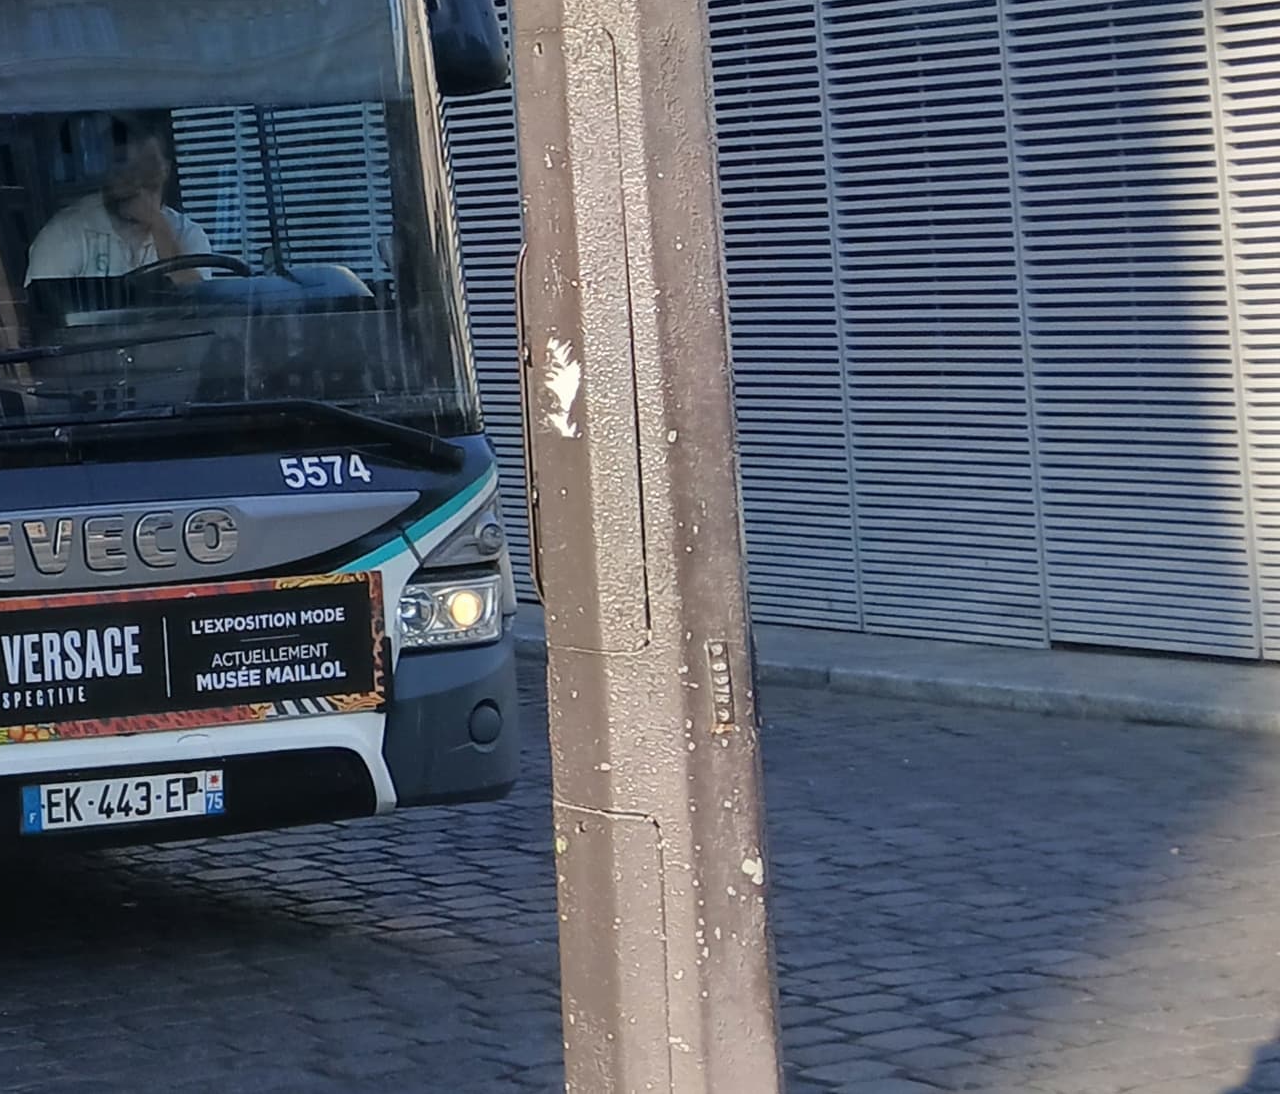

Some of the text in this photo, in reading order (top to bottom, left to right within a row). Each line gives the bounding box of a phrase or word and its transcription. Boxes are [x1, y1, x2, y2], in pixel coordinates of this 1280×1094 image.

[279, 454, 372, 489] 5574
[191, 607, 346, 635] L'EXPOSITION MODE
[1, 625, 143, 685] VERSACE
[211, 642, 329, 668] ACTUELLEMENT
[196, 660, 347, 692] MUSÉE MAILLOL
[206, 792, 224, 811] 75
[28, 812, 37, 823] F
